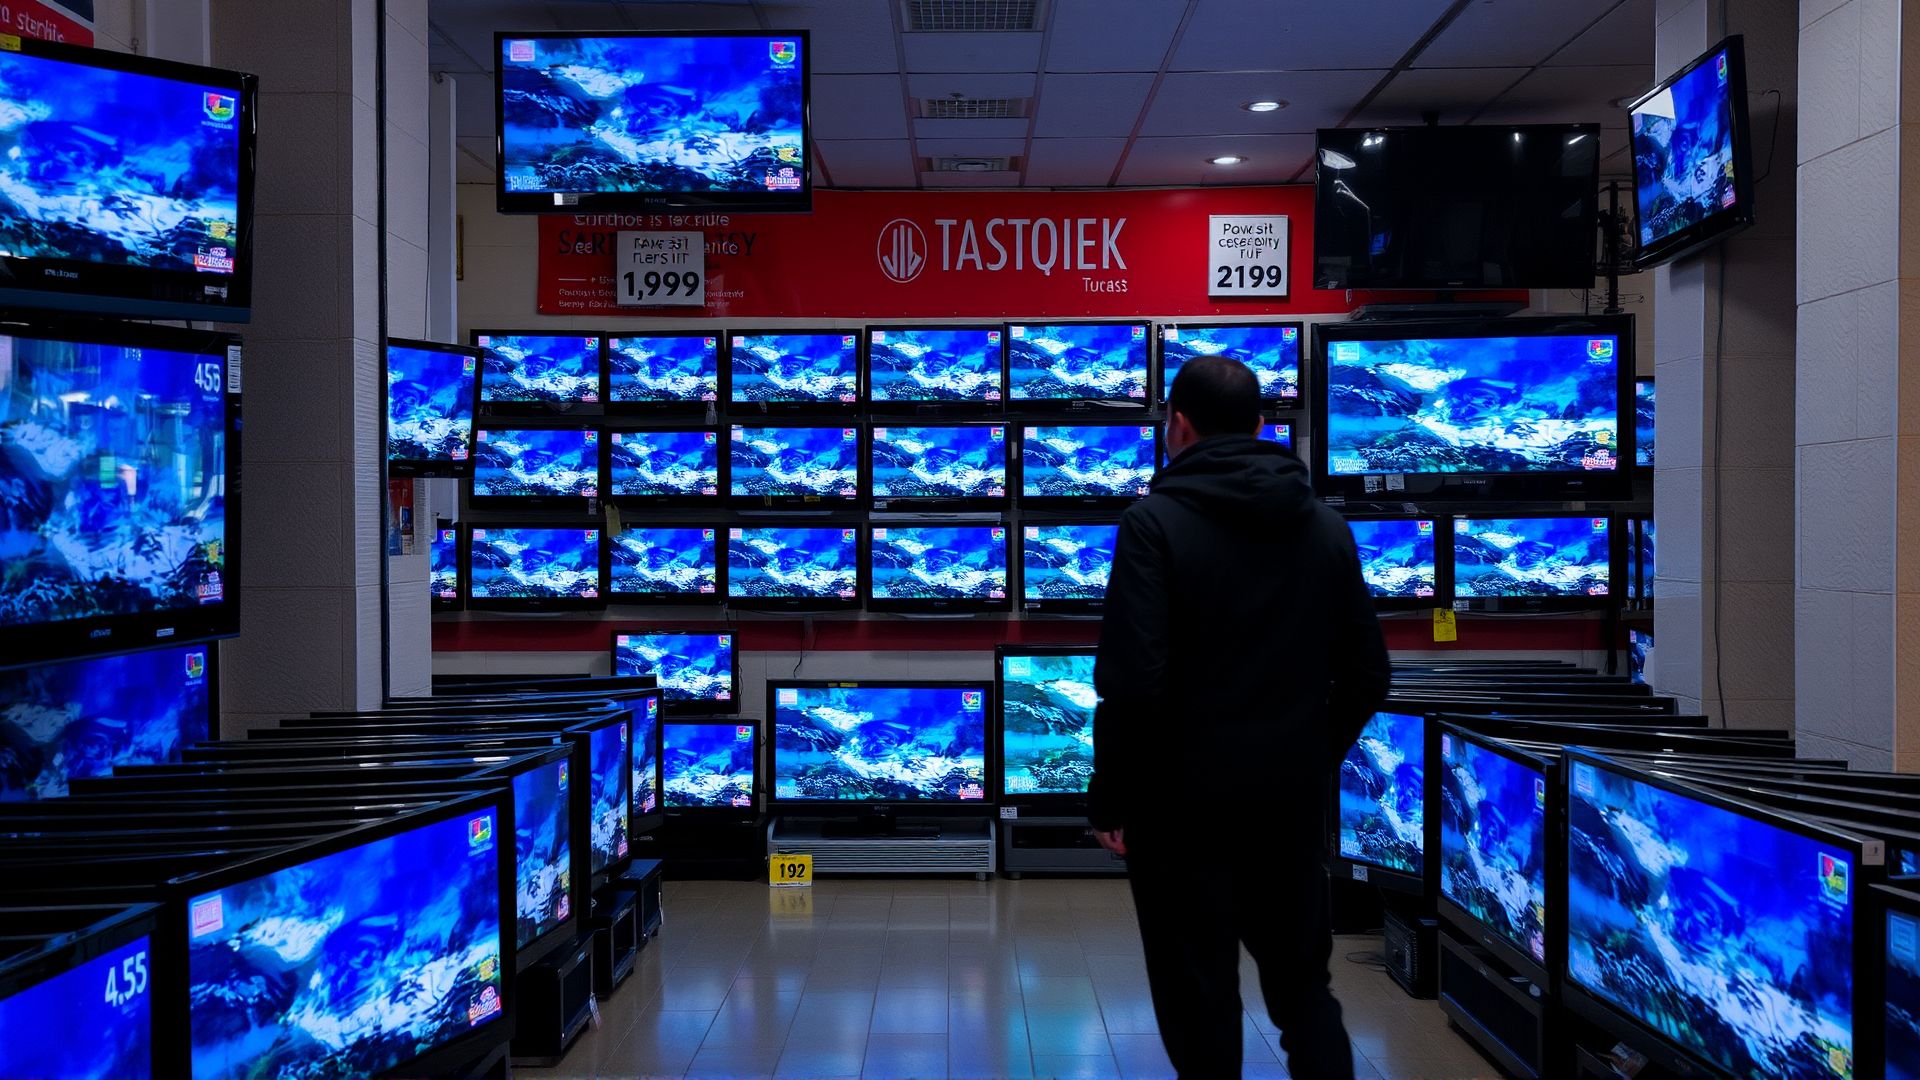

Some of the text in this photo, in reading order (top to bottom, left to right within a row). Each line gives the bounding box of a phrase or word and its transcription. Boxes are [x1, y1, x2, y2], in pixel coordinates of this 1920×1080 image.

[935, 218, 1126, 276] TASTQIEK
[624, 271, 700, 301] 1,999
[1217, 265, 1282, 288] 2199
[780, 863, 806, 879] 192
[104, 951, 148, 1008] 4.55
